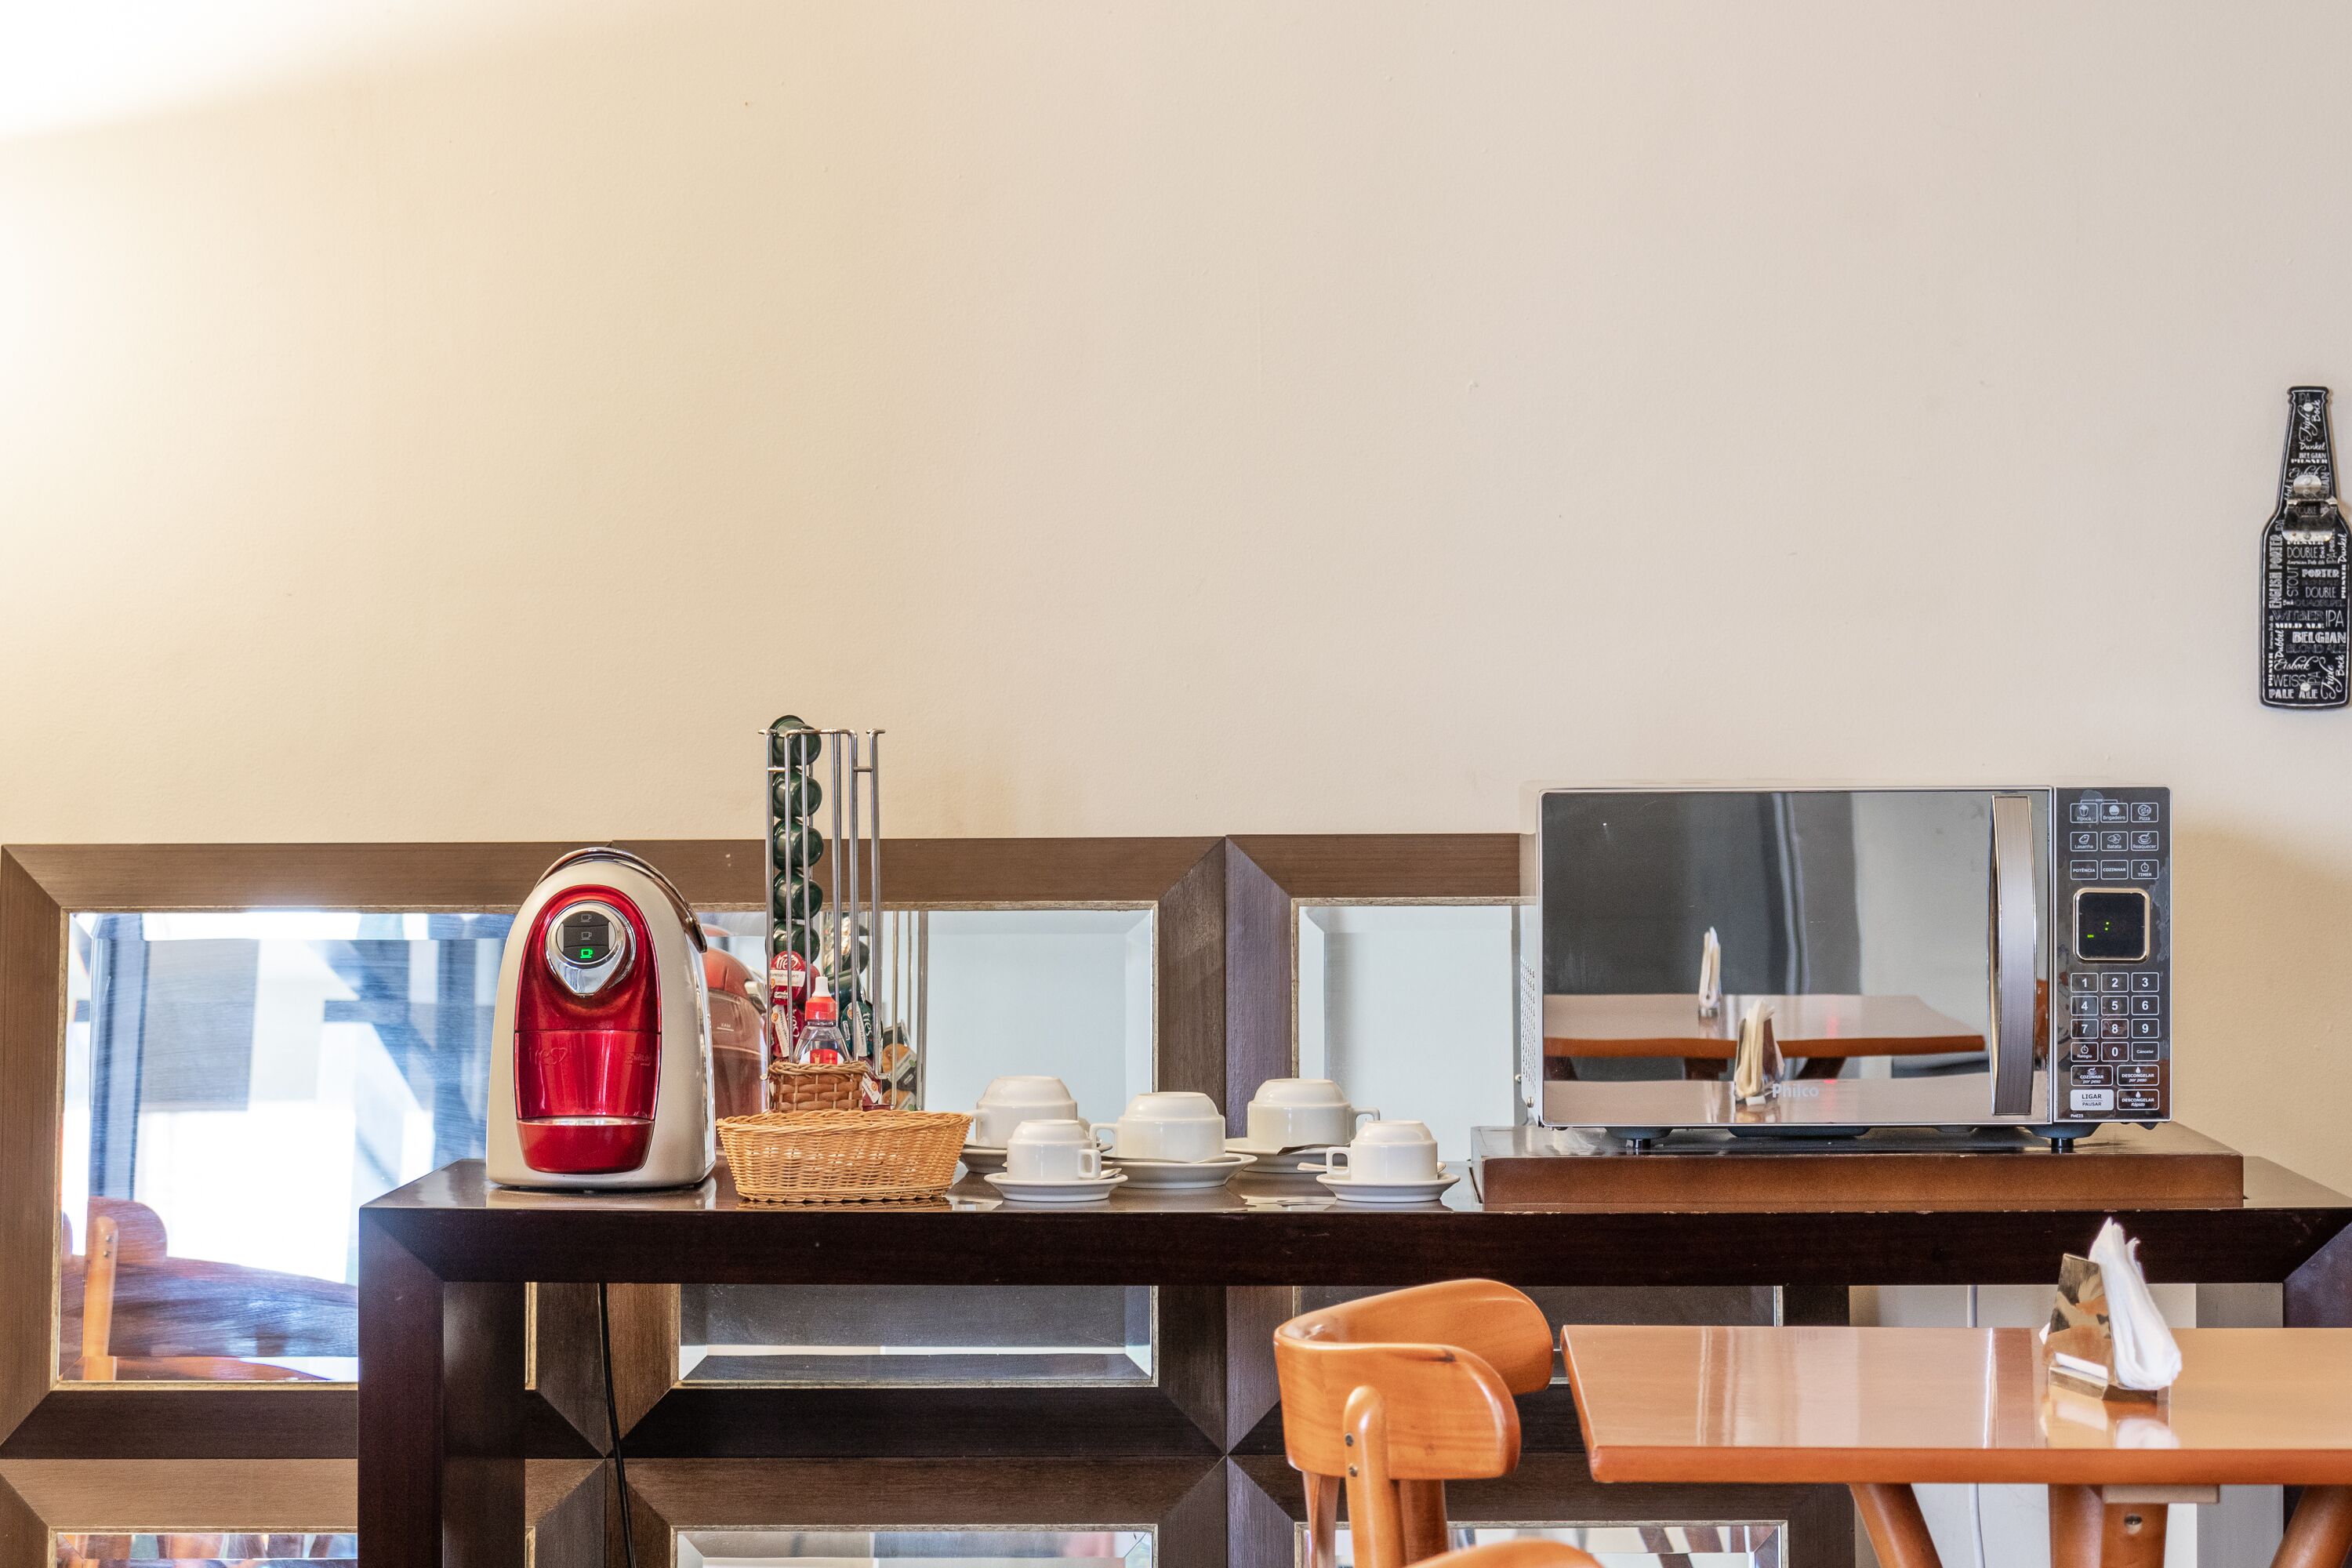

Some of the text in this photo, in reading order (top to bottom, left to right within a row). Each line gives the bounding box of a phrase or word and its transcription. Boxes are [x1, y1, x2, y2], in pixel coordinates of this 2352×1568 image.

[2287, 546, 2318, 558] DOUBLE
[2269, 534, 2282, 608] ENGLISH PORTER
[2302, 568, 2339, 578] PORTER
[2287, 566, 2299, 597] STOUT
[2306, 586, 2336, 598] DOUBLE
[2325, 610, 2344, 627] IPA
[2292, 632, 2347, 644] BELGIAN
[2274, 630, 2285, 659] Dubbel
[2274, 655, 2319, 671] Eisbock
[2274, 674, 2307, 688] WEISS
[2268, 689, 2318, 699] PALE ALE
[2082, 978, 2088, 988] 1
[2111, 978, 2118, 988] 2
[2142, 978, 2149, 987] 3
[2081, 1001, 2089, 1011] 4
[2111, 1001, 2118, 1011] 5
[2141, 1000, 2149, 1011] 6
[2081, 1025, 2089, 1034] 7
[2111, 1024, 2118, 1034] 8
[2141, 1024, 2149, 1033] 9
[2111, 1047, 2118, 1057] 0
[1772, 1083, 1820, 1098] Philco
